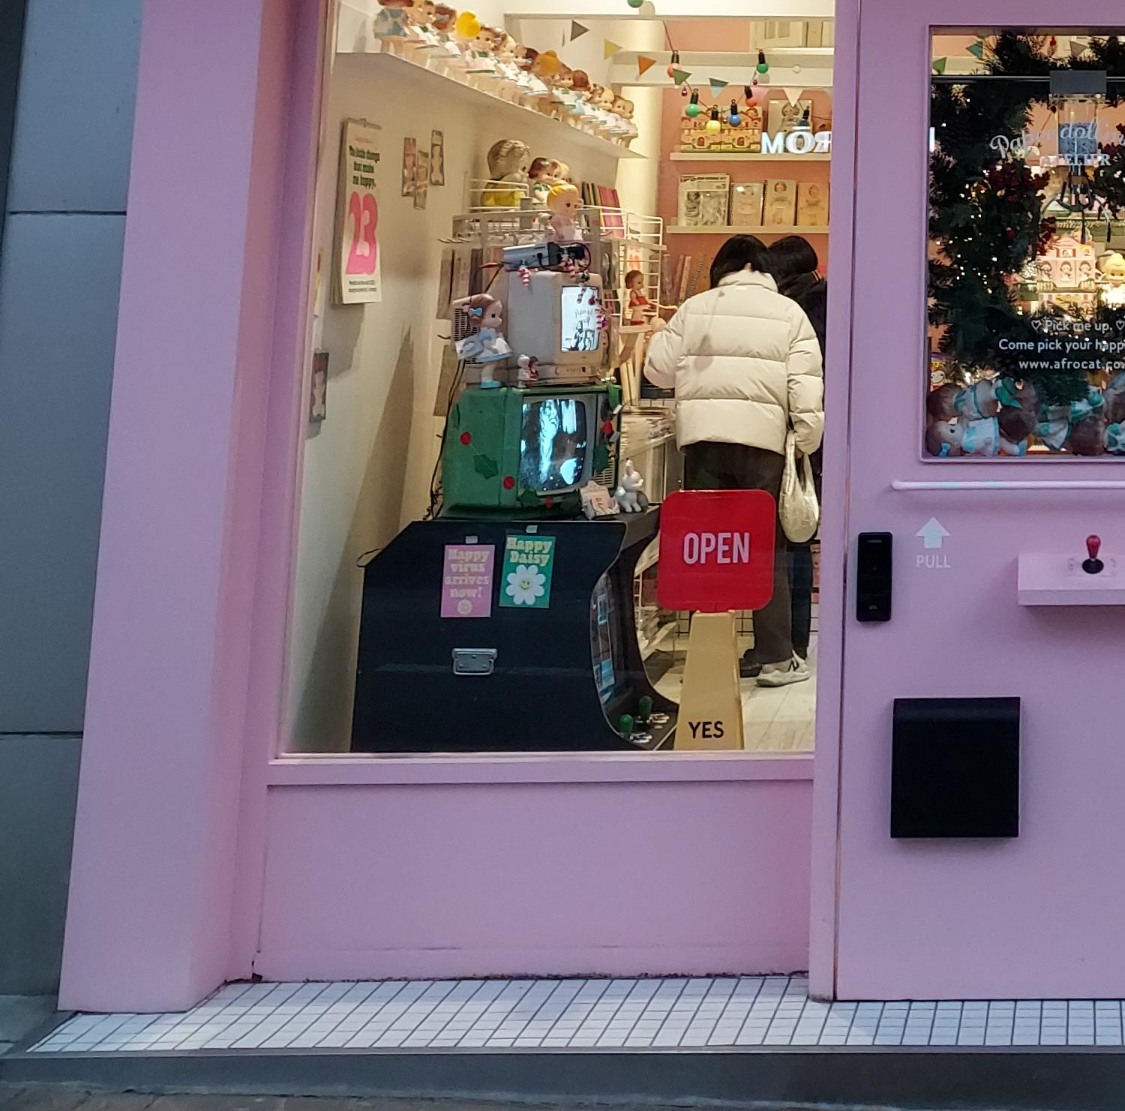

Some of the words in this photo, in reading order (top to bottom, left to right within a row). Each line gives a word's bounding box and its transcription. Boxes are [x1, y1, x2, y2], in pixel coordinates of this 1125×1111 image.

[345, 191, 378, 275] 23
[1045, 321, 1070, 331] Pick
[1073, 323, 1091, 331] me
[1094, 322, 1113, 333] up.
[999, 339, 1034, 350] Come
[1037, 339, 1062, 353] pick
[1065, 341, 1092, 353] your
[506, 537, 552, 553] Happy
[683, 532, 750, 564] OPEN
[447, 549, 489, 562] Happy
[510, 551, 550, 567] Daisy
[916, 554, 951, 568] PULL
[450, 561, 486, 572] virus
[444, 573, 489, 585] arrives
[688, 721, 724, 738] YES
